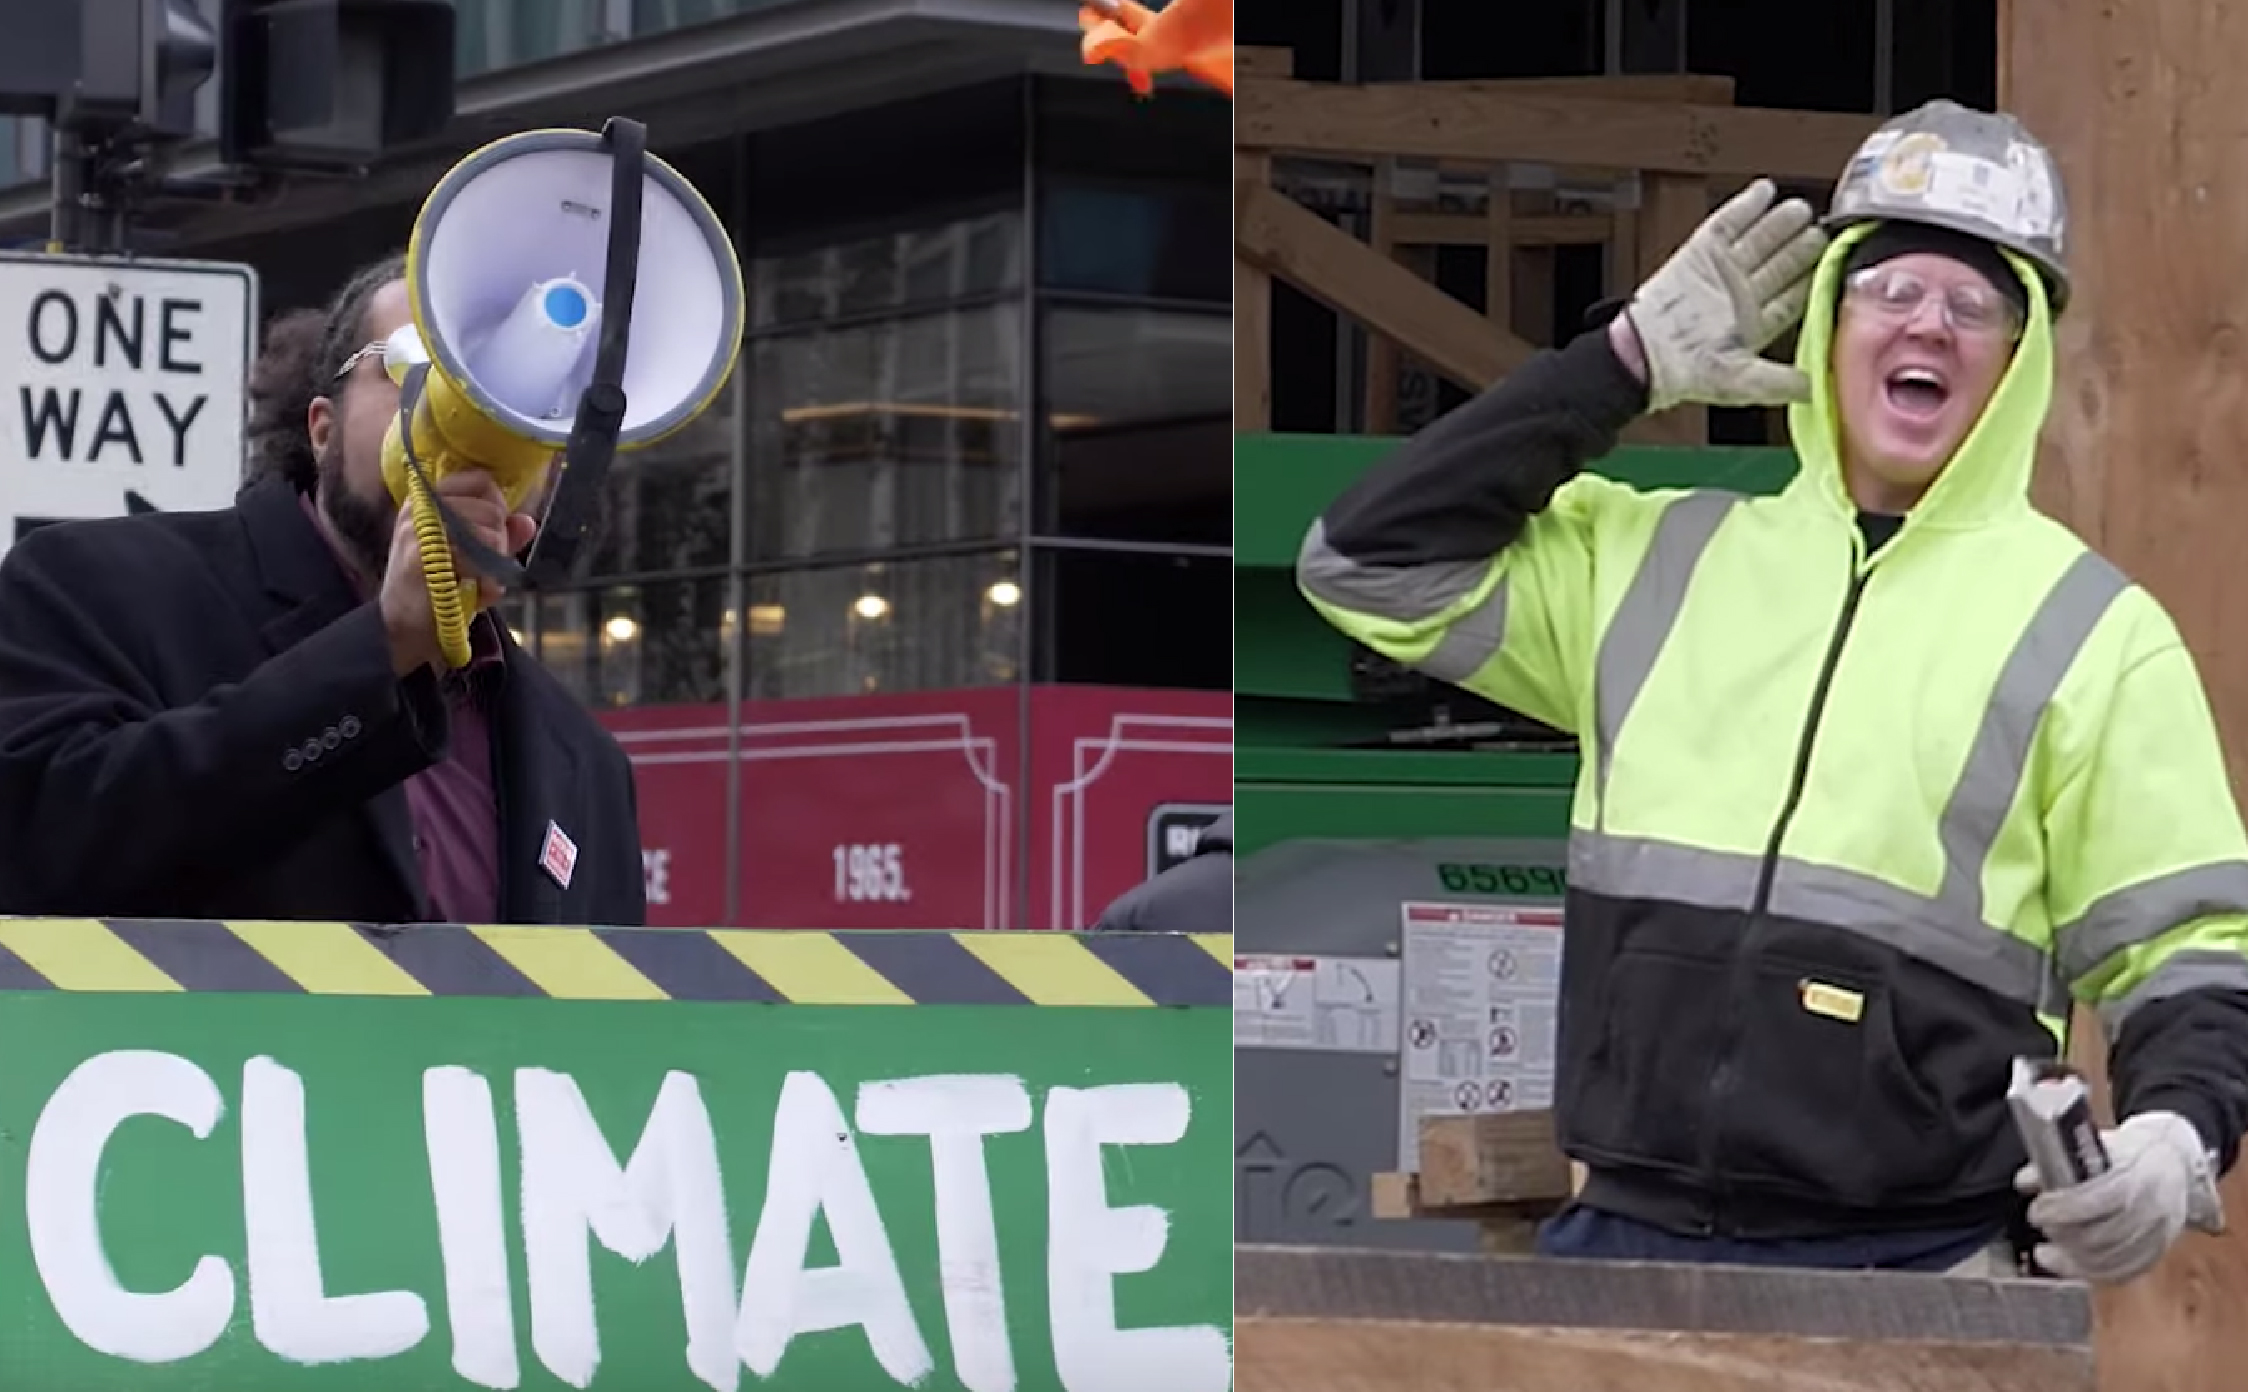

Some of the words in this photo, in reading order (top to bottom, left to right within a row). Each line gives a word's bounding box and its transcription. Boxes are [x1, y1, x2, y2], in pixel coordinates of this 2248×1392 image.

[28, 286, 203, 374] ONE
[20, 385, 209, 468] WAY
[832, 844, 912, 903] 1965.
[26, 1049, 1232, 1392] CLIMATE
